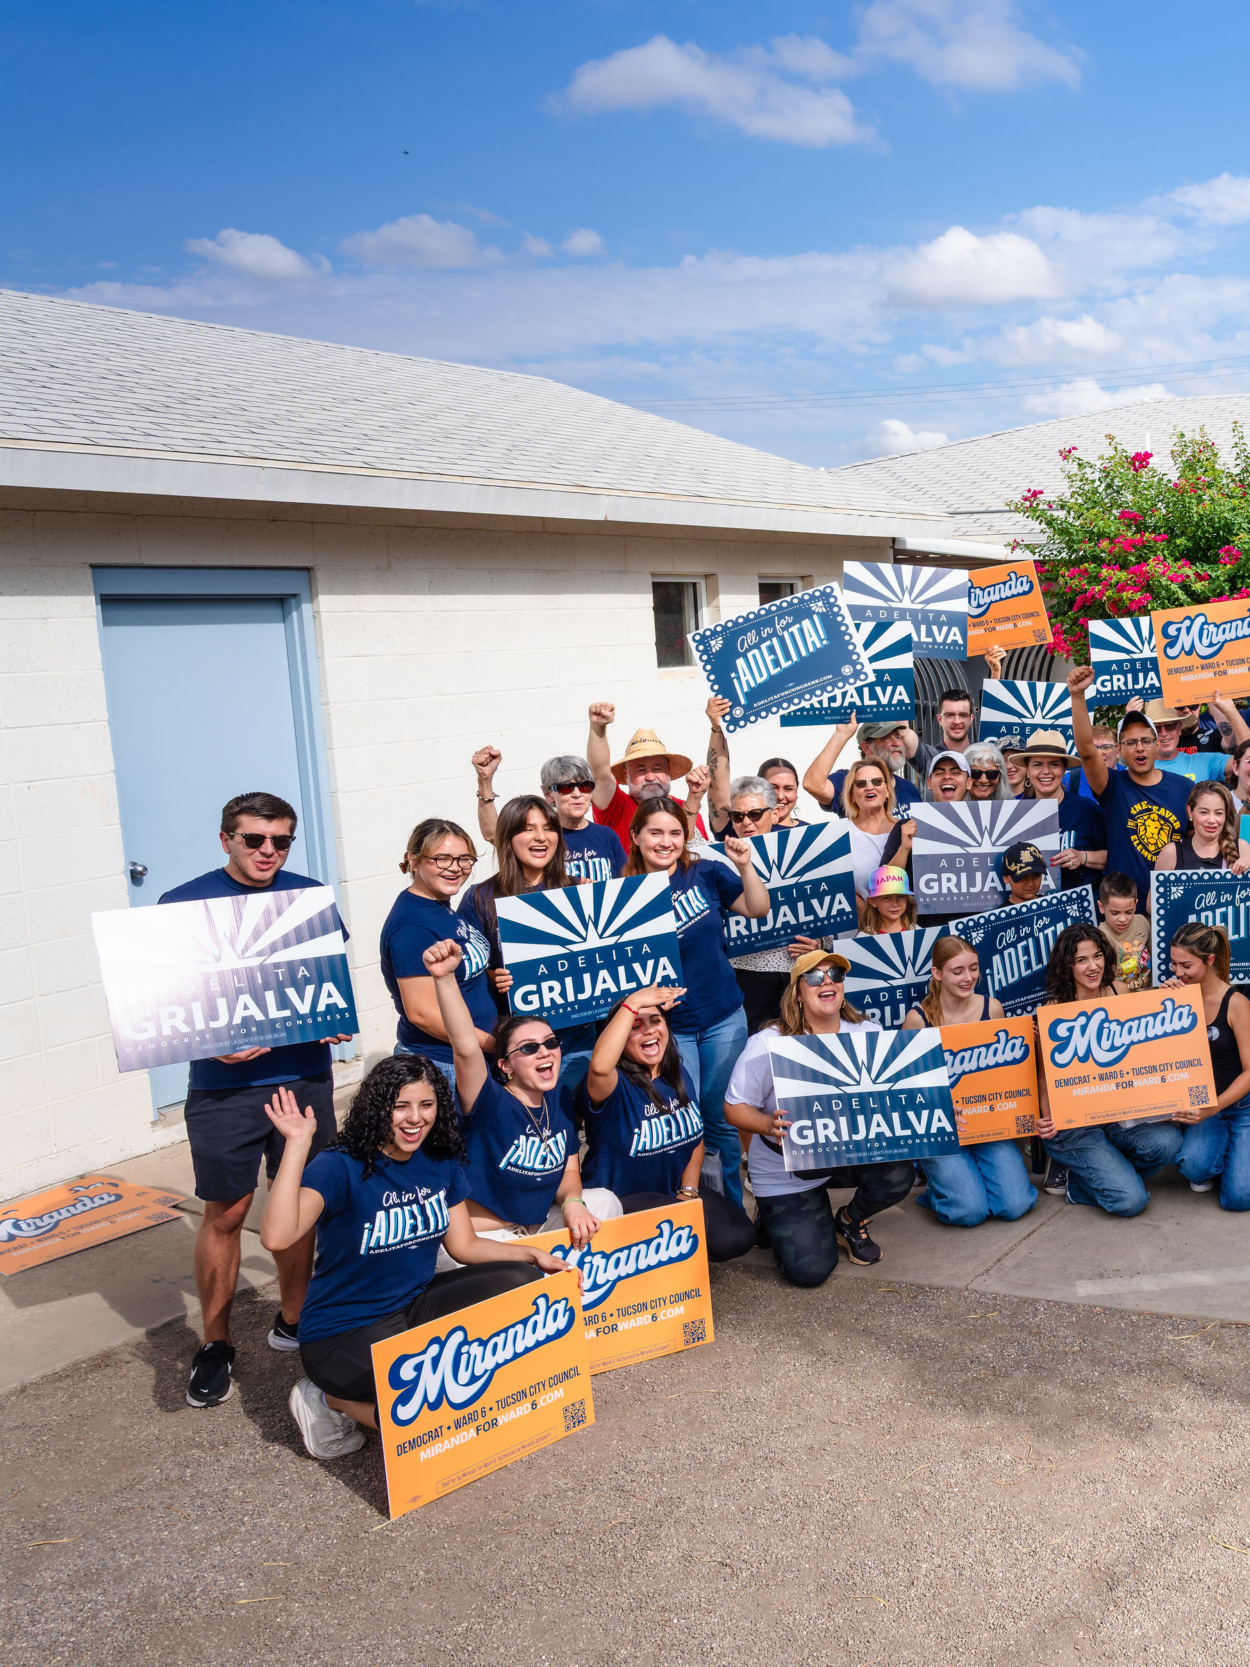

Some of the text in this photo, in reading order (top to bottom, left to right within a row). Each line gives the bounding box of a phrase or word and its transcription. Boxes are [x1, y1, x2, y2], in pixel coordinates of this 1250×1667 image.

[866, 609, 947, 622] ADELITA
[1021, 612, 1040, 620] COUNCIL
[738, 616, 793, 652] All in for
[1167, 664, 1194, 676] DEMOCRAT
[1200, 662, 1214, 671] WARD
[1225, 657, 1246, 667] TUCSON
[1130, 835, 1159, 862] ELEMEN
[876, 875, 904, 886] JAPAN
[1195, 886, 1217, 910] All
[1220, 890, 1232, 903] in
[803, 914, 853, 930] CONGRESS
[996, 916, 1050, 949] All in for
[538, 943, 651, 976] ADELITA
[513, 956, 678, 1012] GRIJALVA
[121, 982, 348, 1040] GRIJALVA
[126, 1012, 350, 1053] DEMOCRAT FOR CONGRESS
[1052, 1000, 1195, 1066] Miranda
[1055, 1058, 1203, 1088] DEMOCRAT WARD 6 TUCSON CITY COUNCIL
[1072, 1072, 1189, 1097] MIRANDAFORWARD6.COM
[812, 1093, 925, 1112] ADELITA
[960, 1088, 1032, 1106] TUCSON CITY COUNCIL
[789, 1108, 953, 1145] GRIJALVA
[792, 1144, 854, 1155] DEMOCRAT
[900, 1136, 956, 1145] CONGRESS
[402, 1186, 431, 1204] in for
[601, 1288, 702, 1322] 6 TUCSON CITY COUNCIL
[393, 1295, 573, 1423] Miranda
[396, 1365, 580, 1457] DEMOCRAT WARD 6 TUCSON CITY COUNCIL
[420, 1388, 564, 1462] MIRANDAFORWARD6.COM
